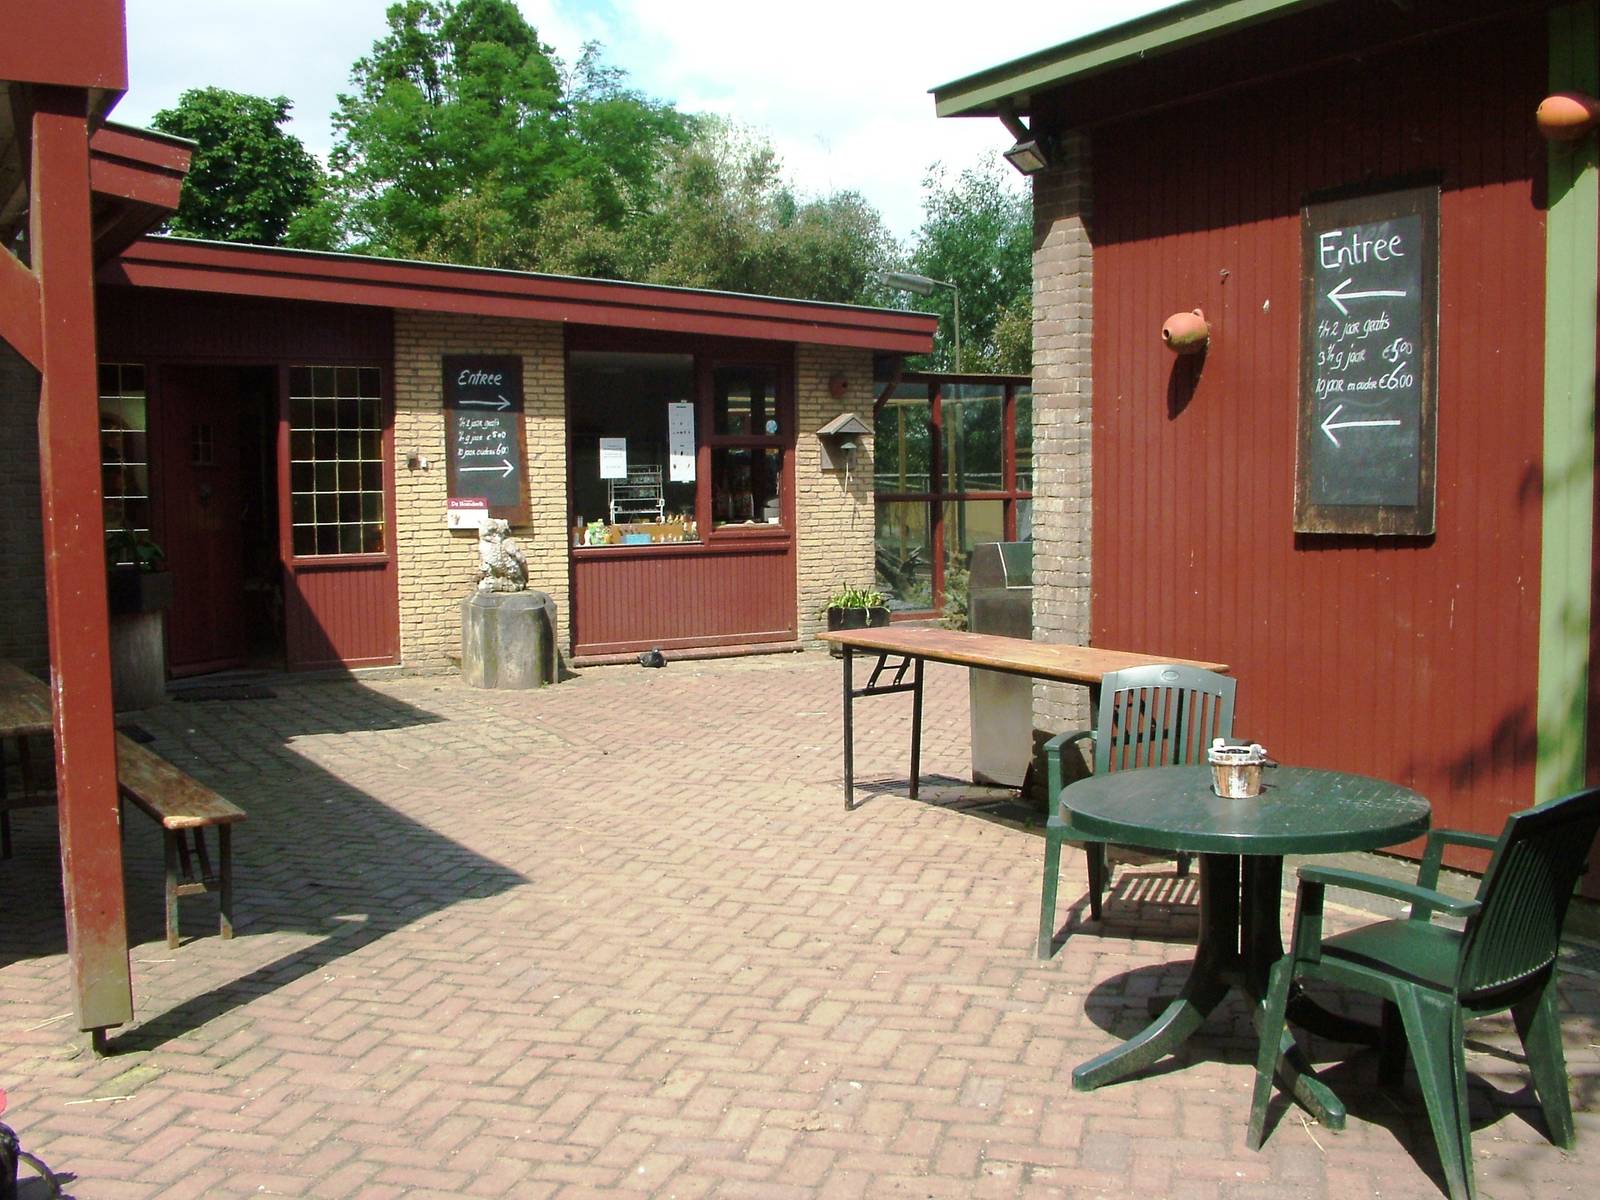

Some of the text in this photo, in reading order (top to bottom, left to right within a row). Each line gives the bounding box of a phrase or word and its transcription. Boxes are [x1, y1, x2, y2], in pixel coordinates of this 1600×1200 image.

[1320, 231, 1405, 269] Entree
[1329, 321, 1339, 336] 2
[1337, 315, 1360, 342] jaar
[1357, 311, 1390, 339] gratis
[1318, 351, 1326, 366] 3
[1341, 343, 1366, 371] jaar
[458, 369, 502, 386] Entree
[1320, 371, 1344, 400] jaar
